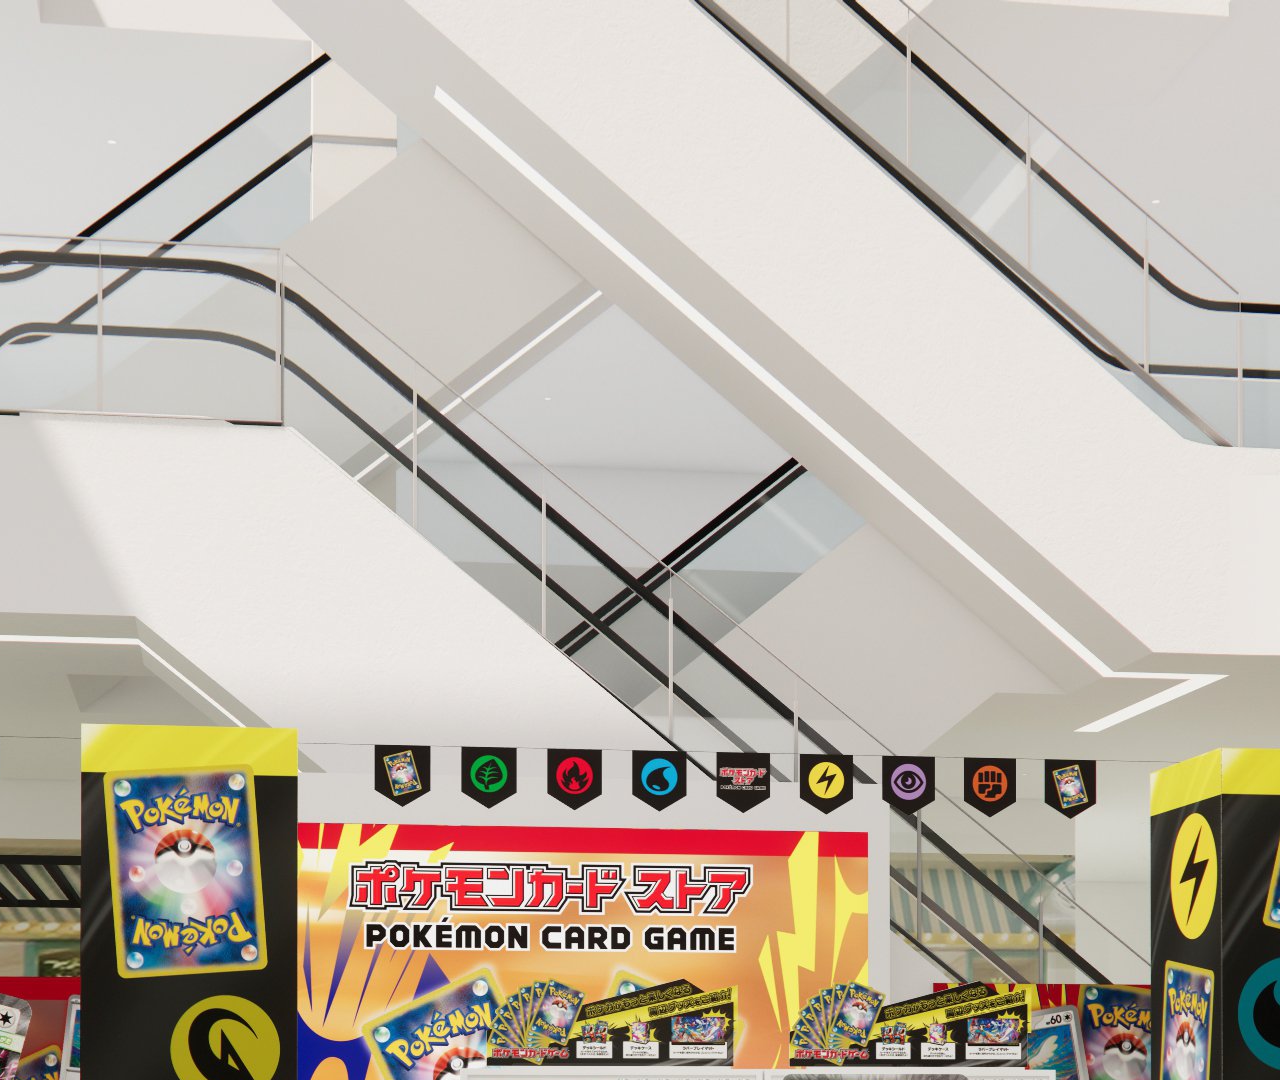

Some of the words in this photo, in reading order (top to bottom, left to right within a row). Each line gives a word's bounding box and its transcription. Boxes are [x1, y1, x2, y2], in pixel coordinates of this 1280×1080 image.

[350, 860, 625, 914] ポケモンカード
[623, 864, 754, 915] ストア
[365, 916, 530, 950] POKÉMON
[540, 924, 632, 951] CARD
[644, 925, 737, 952] GAME
[492, 1047, 569, 1059] ポケモンカードゲーム
[795, 1049, 869, 1059] ポケモンカードゲーム
